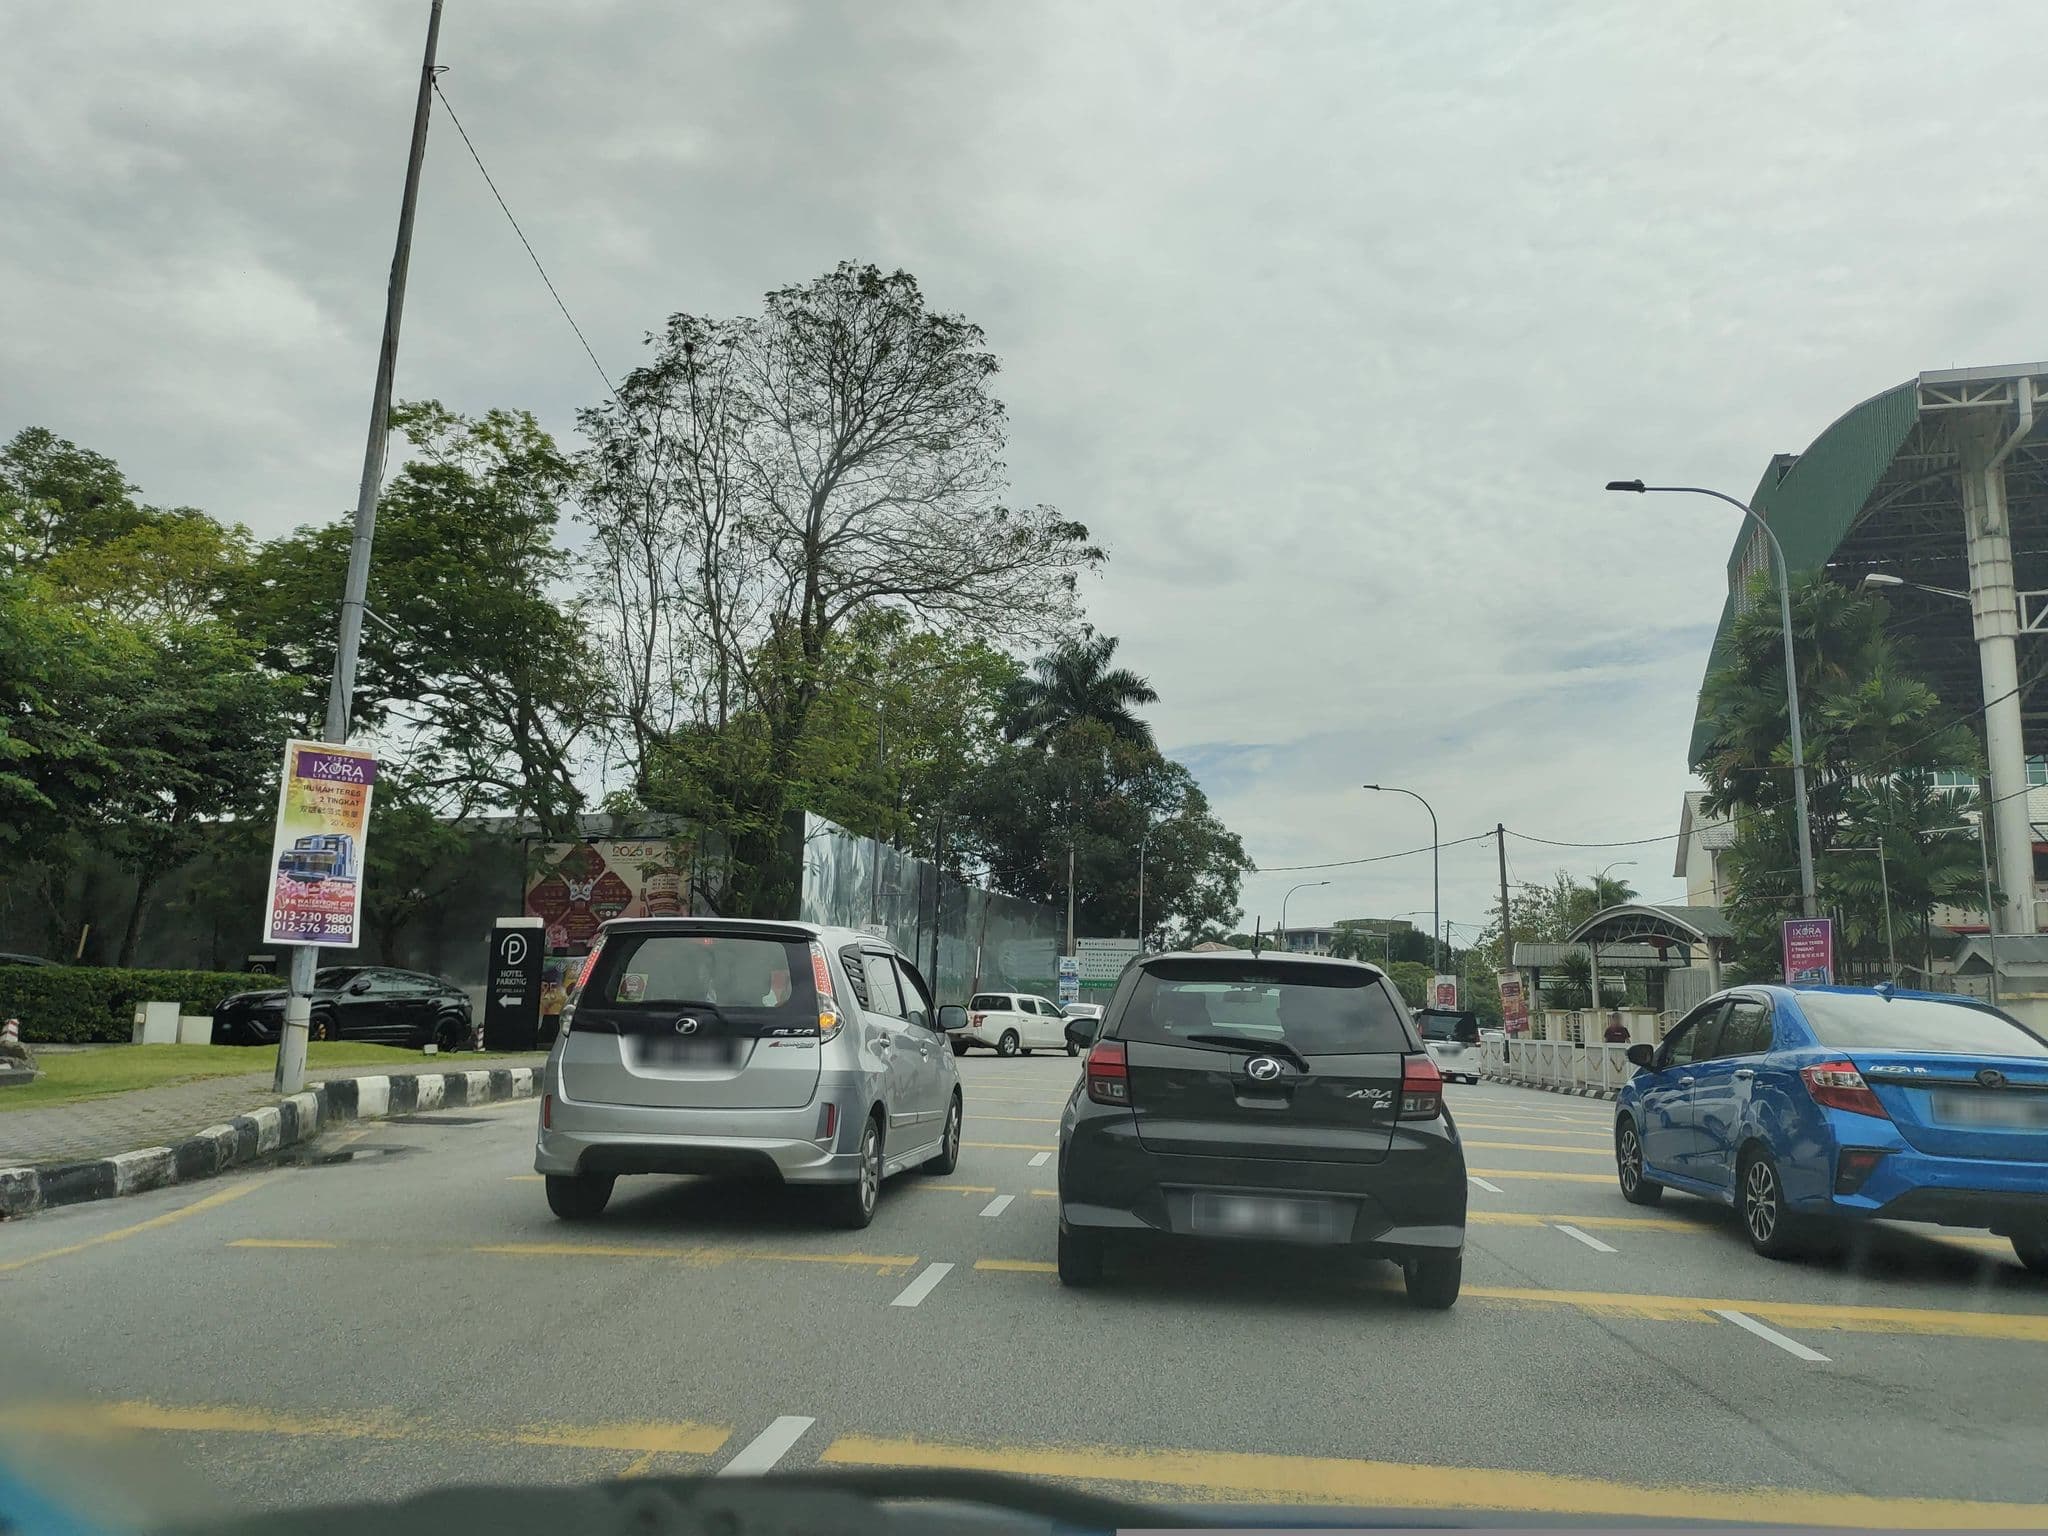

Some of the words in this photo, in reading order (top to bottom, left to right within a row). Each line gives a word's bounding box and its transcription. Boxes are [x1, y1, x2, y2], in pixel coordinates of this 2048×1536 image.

[327, 755, 354, 764] VISTA
[313, 760, 364, 778] IXORA
[303, 784, 334, 793] RUMAH
[336, 787, 361, 797] TERES
[327, 797, 360, 806] TINGKAT
[274, 910, 321, 923] 013-230
[325, 913, 353, 924] 9880
[273, 921, 321, 934] 012-576
[323, 924, 352, 935] 2880
[1792, 927, 1822, 936] IXORA
[500, 969, 524, 978] HOTEL
[495, 978, 527, 986] PARKING
[1869, 1065, 1911, 1073] BEZZA
[1346, 1088, 1392, 1098] AXIA
